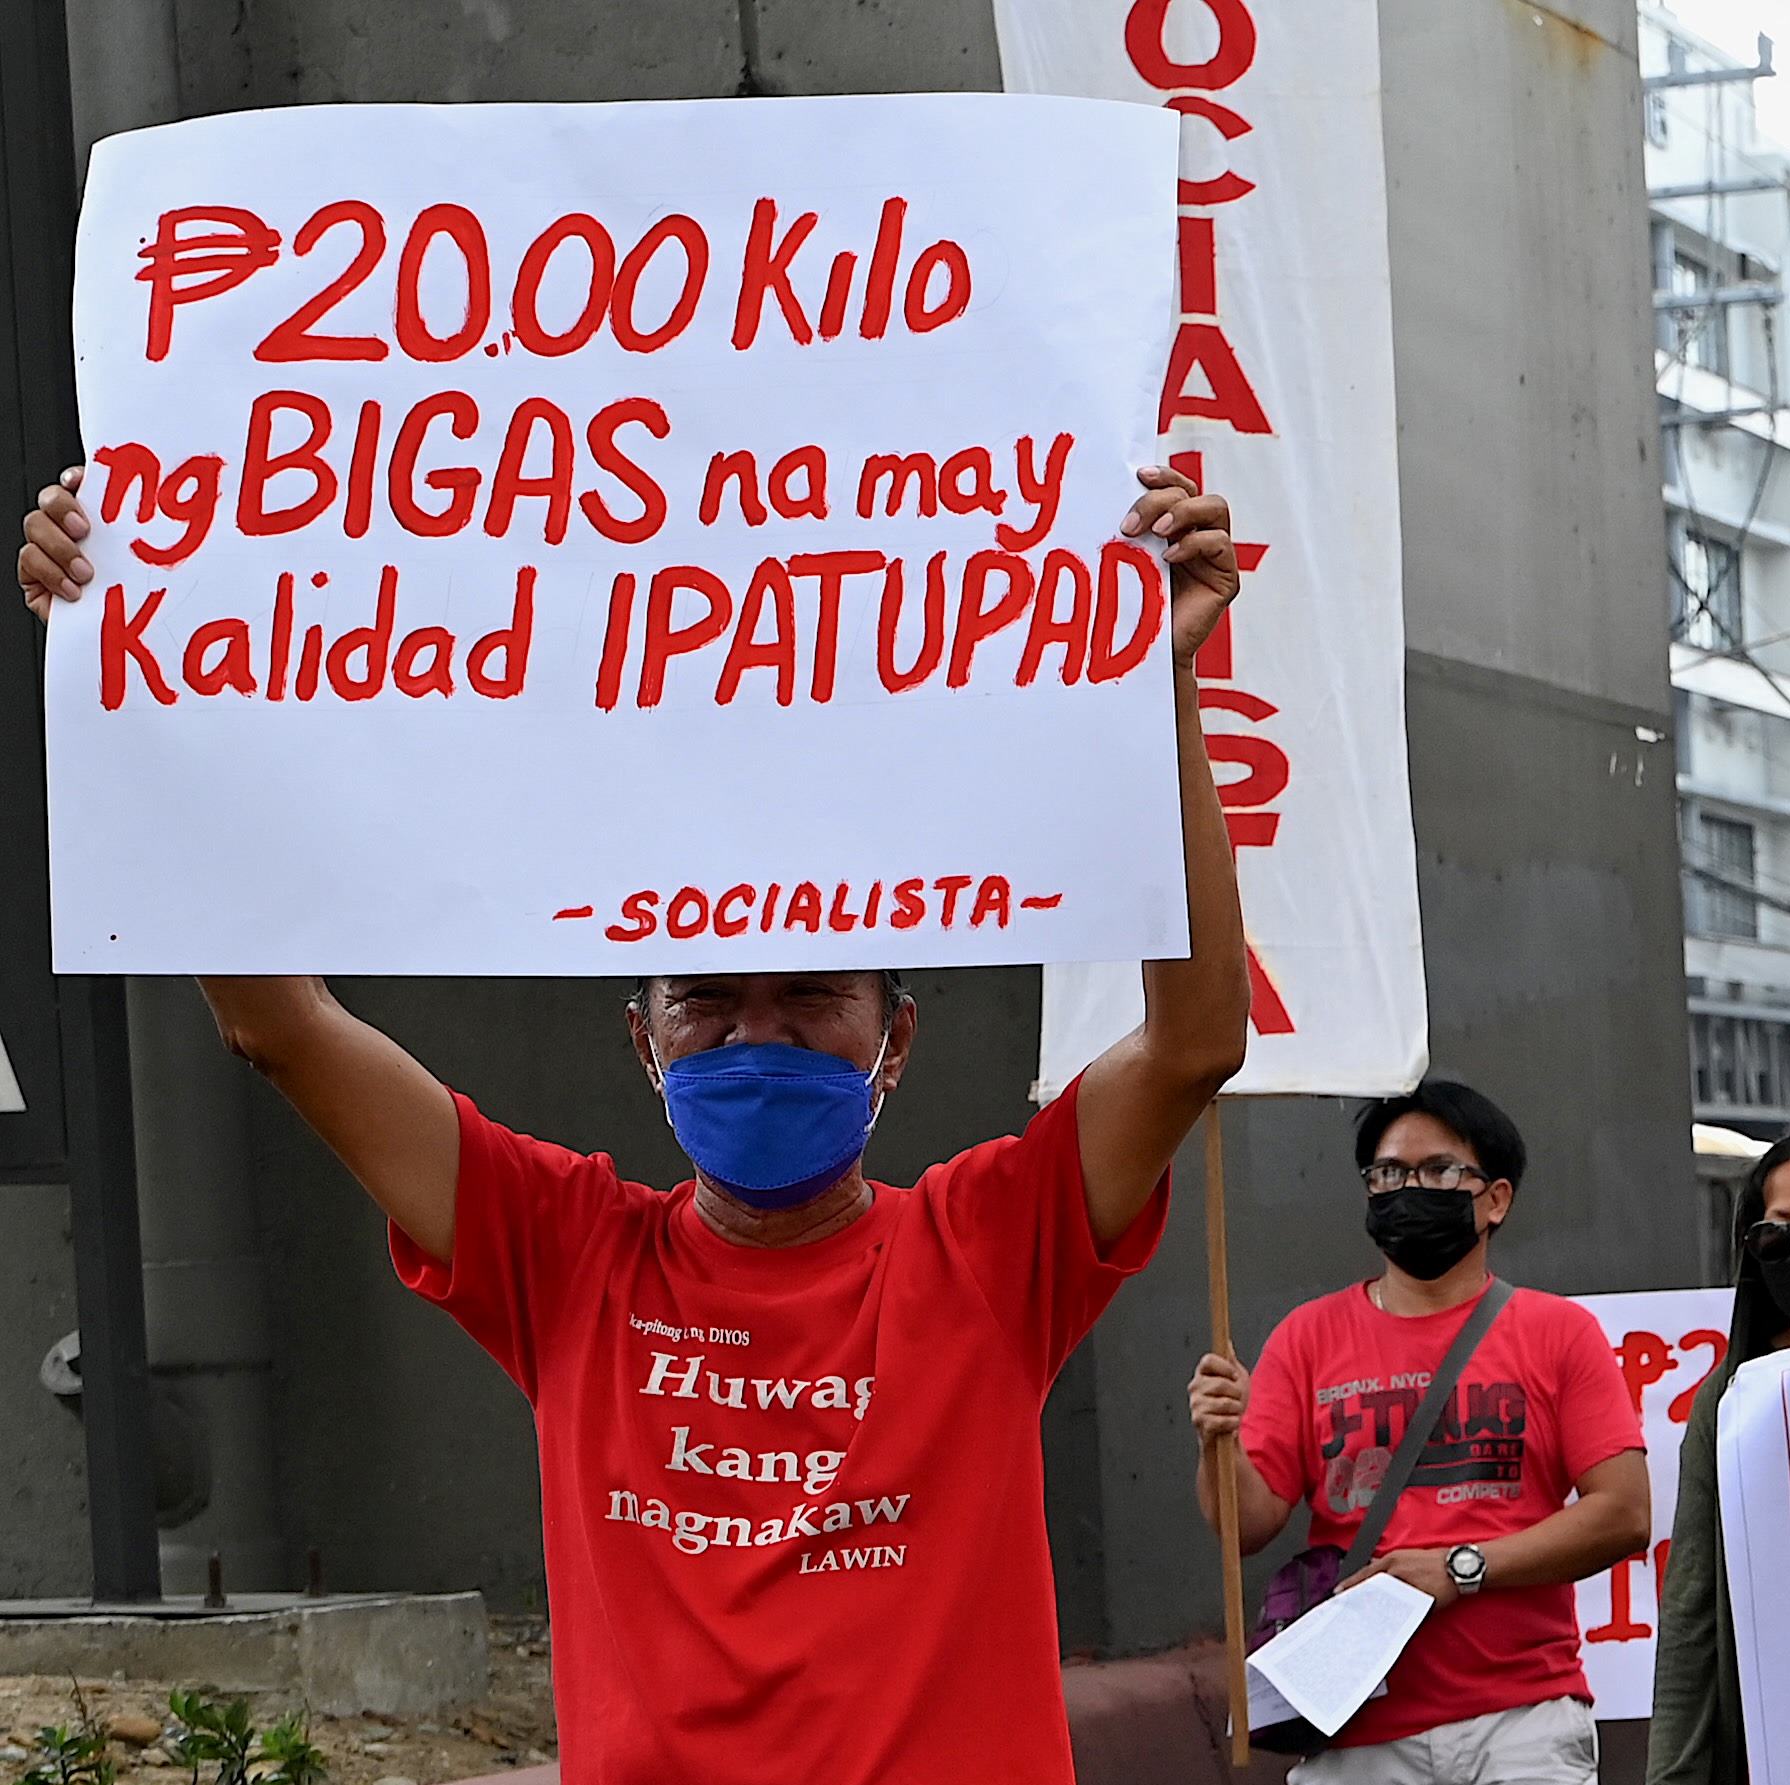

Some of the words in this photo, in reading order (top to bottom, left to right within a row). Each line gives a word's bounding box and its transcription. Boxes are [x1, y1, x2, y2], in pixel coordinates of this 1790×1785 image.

[135, 199, 710, 364] ₱20.00
[731, 196, 973, 351] Kilo
[93, 441, 225, 566] ng
[236, 389, 674, 545] BIGAS
[699, 442, 830, 527] na
[857, 431, 1075, 553] may
[100, 565, 537, 711] Kalidad
[595, 535, 1165, 712] IPATUPAD
[629, 1312, 683, 1342] ka-pitong
[709, 1327, 750, 1346] DIYOS
[639, 1350, 876, 1421] Huwag
[1390, 1371, 1432, 1391] NYC
[1612, 1329, 1728, 1423] ₱2
[665, 1426, 848, 1495] kang
[1436, 1483, 1521, 1505] COMPETE
[799, 1544, 907, 1575] LAWIN
